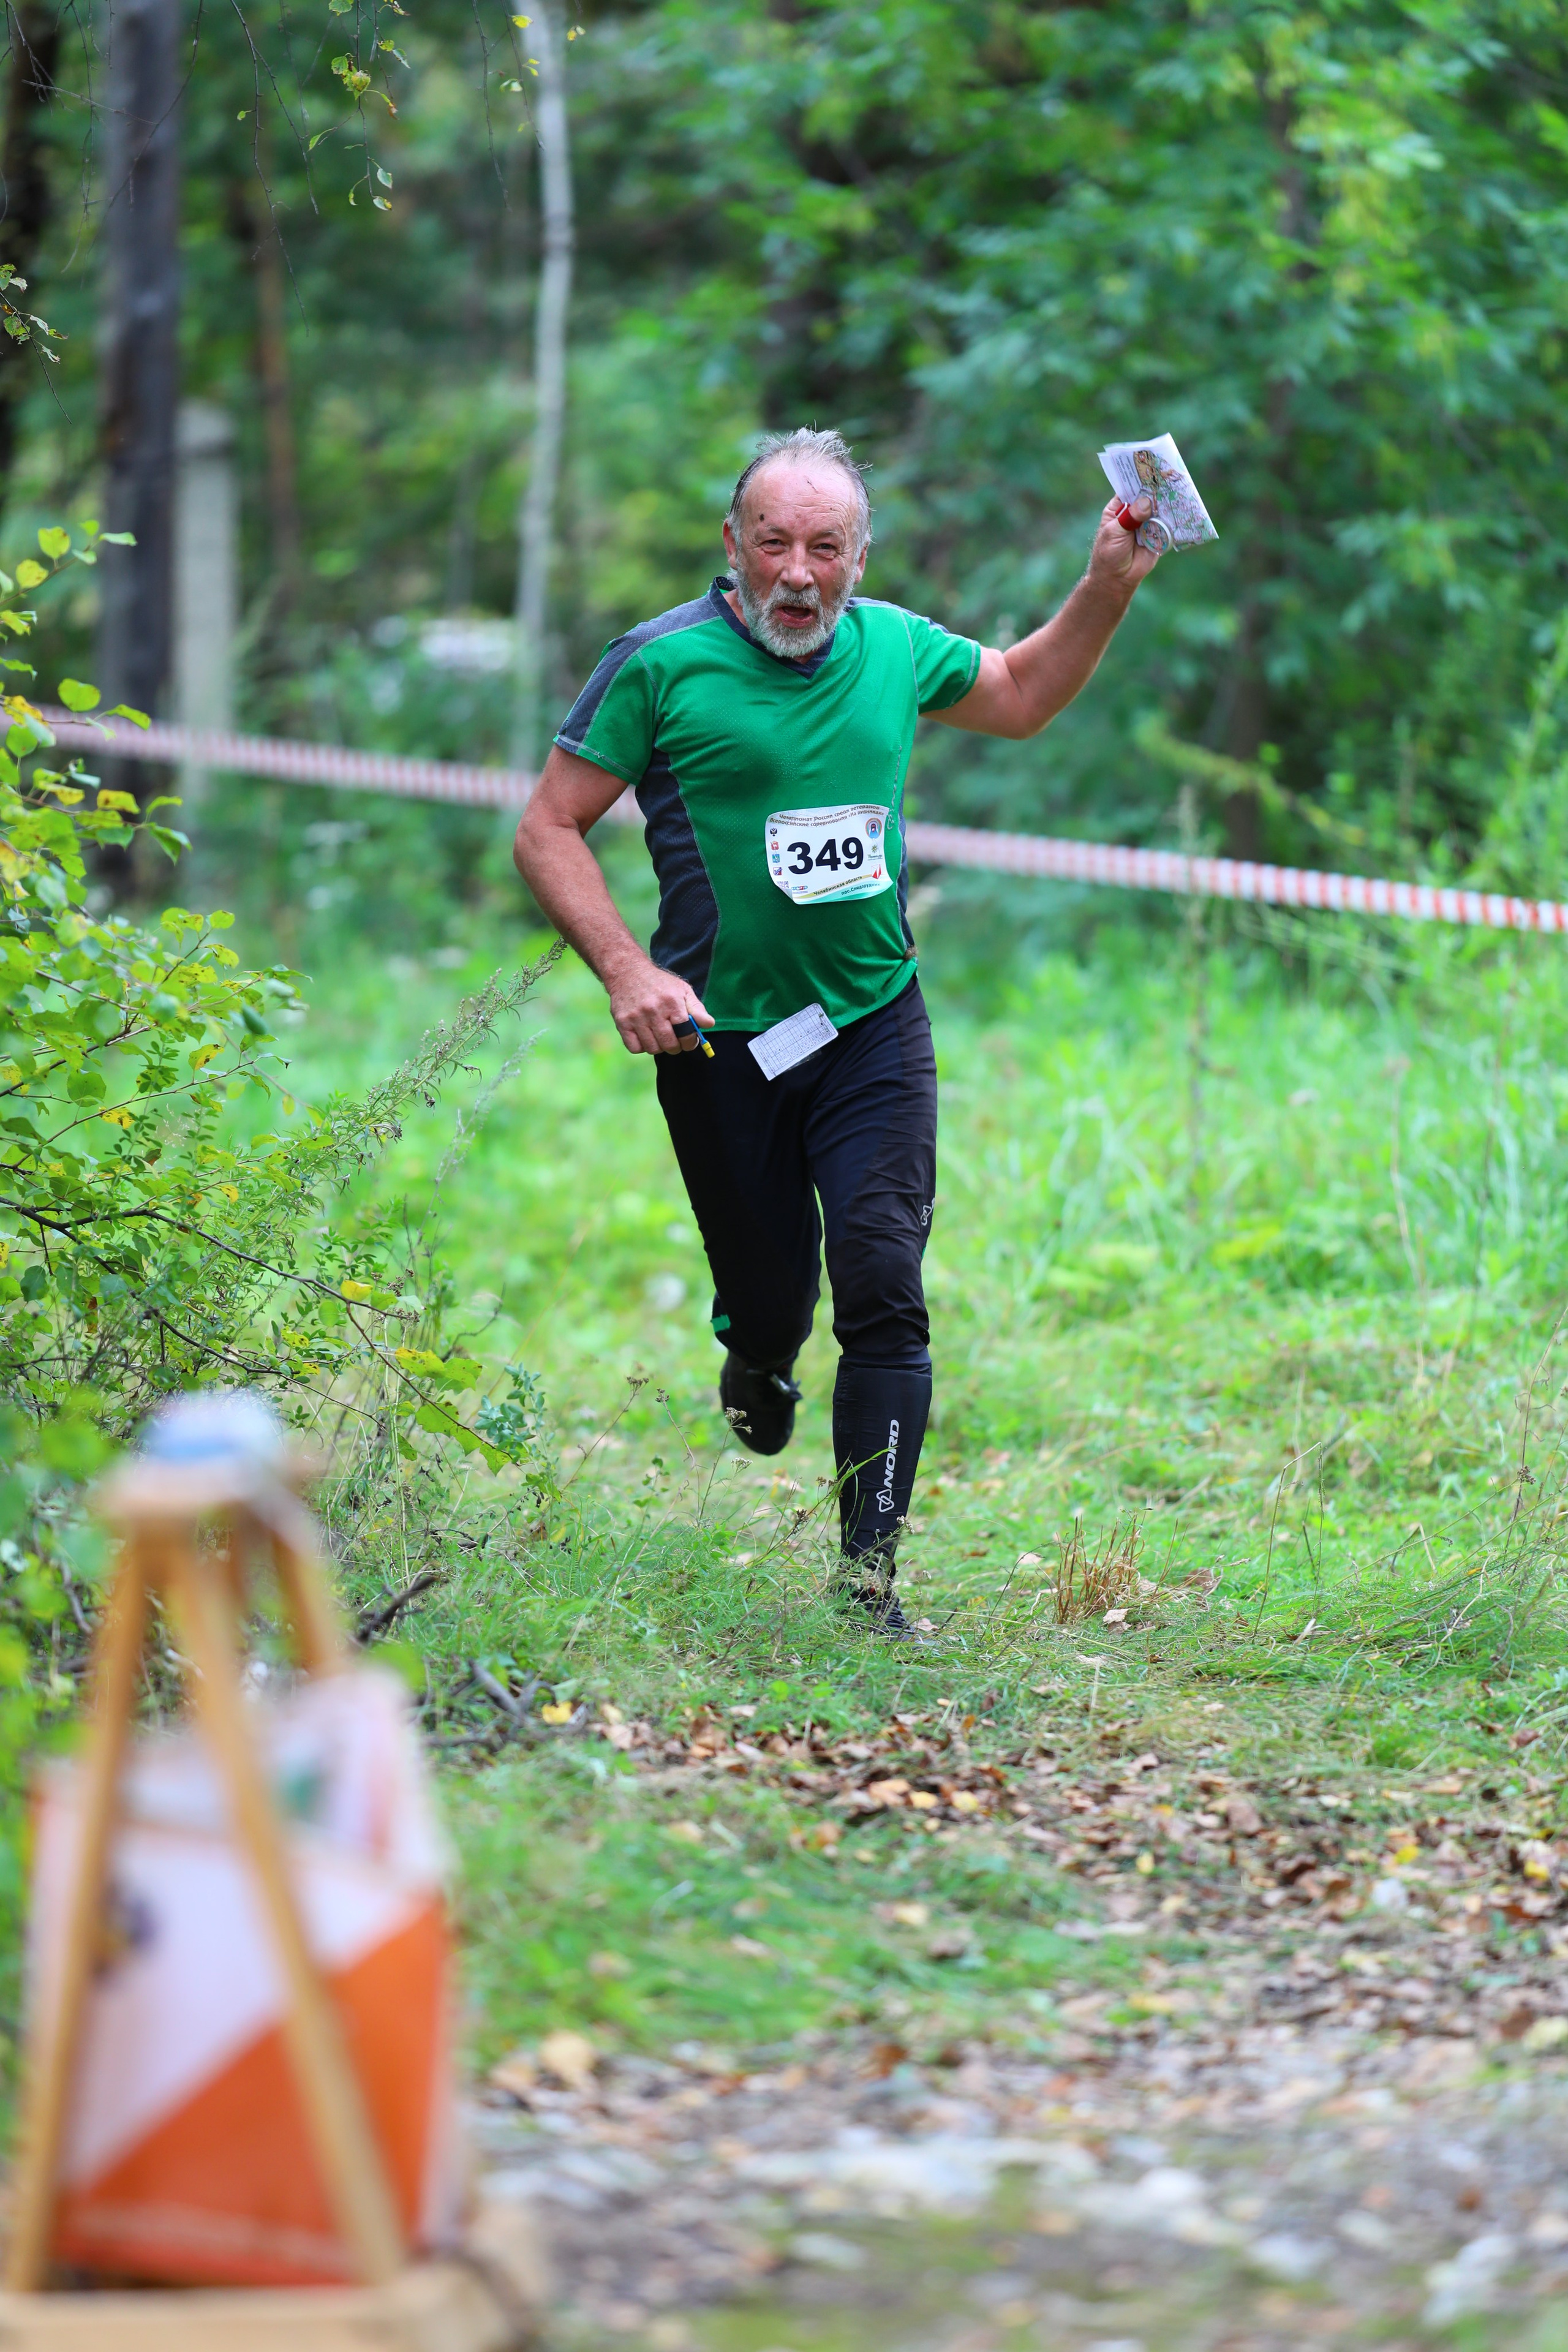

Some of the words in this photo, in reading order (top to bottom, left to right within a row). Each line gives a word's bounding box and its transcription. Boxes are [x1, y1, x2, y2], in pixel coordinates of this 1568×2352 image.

[770, 818, 809, 826] Всероссийские
[810, 815, 848, 827] соревнования
[787, 837, 864, 875] 349
[813, 882, 845, 895] Челябинская
[845, 876, 862, 885] область
[884, 1419, 899, 1489] NORD
